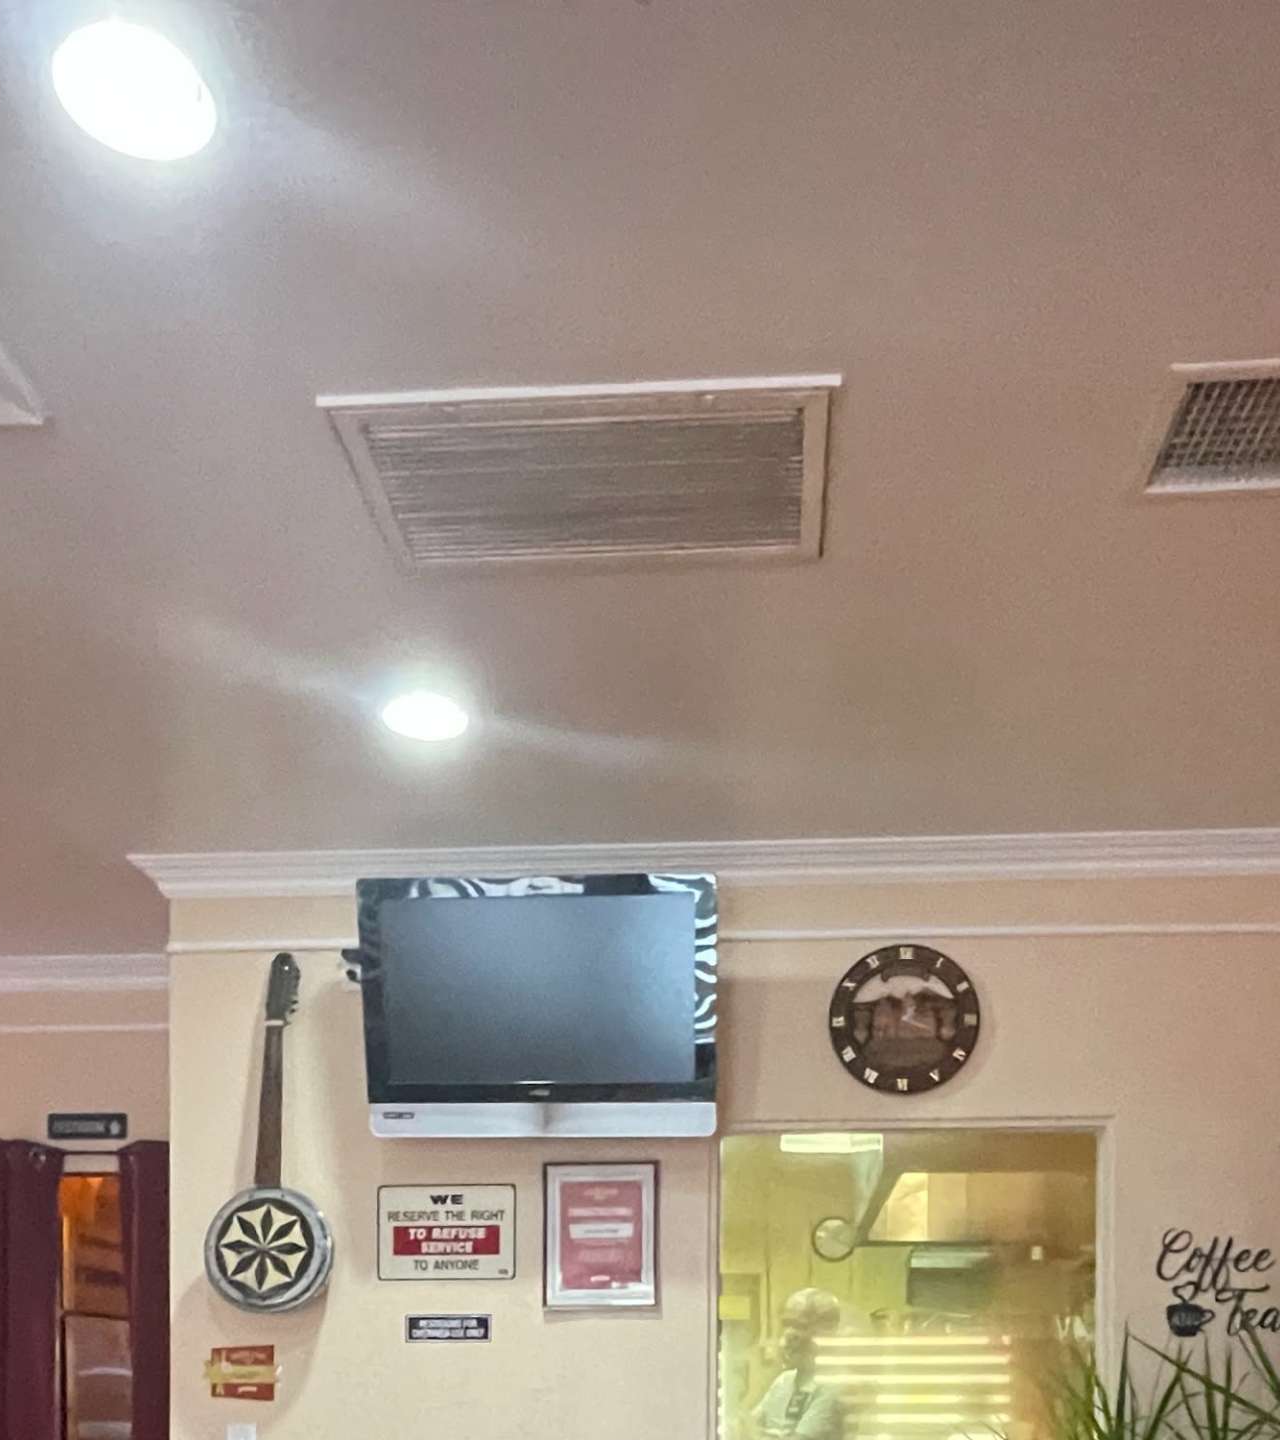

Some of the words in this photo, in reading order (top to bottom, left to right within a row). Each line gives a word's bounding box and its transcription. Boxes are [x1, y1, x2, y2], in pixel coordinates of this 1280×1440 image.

[430, 1194, 464, 1205] WE
[387, 1210, 439, 1222] RESERVE
[445, 1210, 466, 1221] THE
[471, 1209, 505, 1221] RIGHT
[408, 1228, 426, 1240] TO
[432, 1227, 486, 1239] REFUSE
[421, 1241, 473, 1254] SERVICE
[413, 1259, 428, 1271] TO
[433, 1259, 480, 1271] ANYONE
[1156, 1228, 1276, 1292] Coffee
